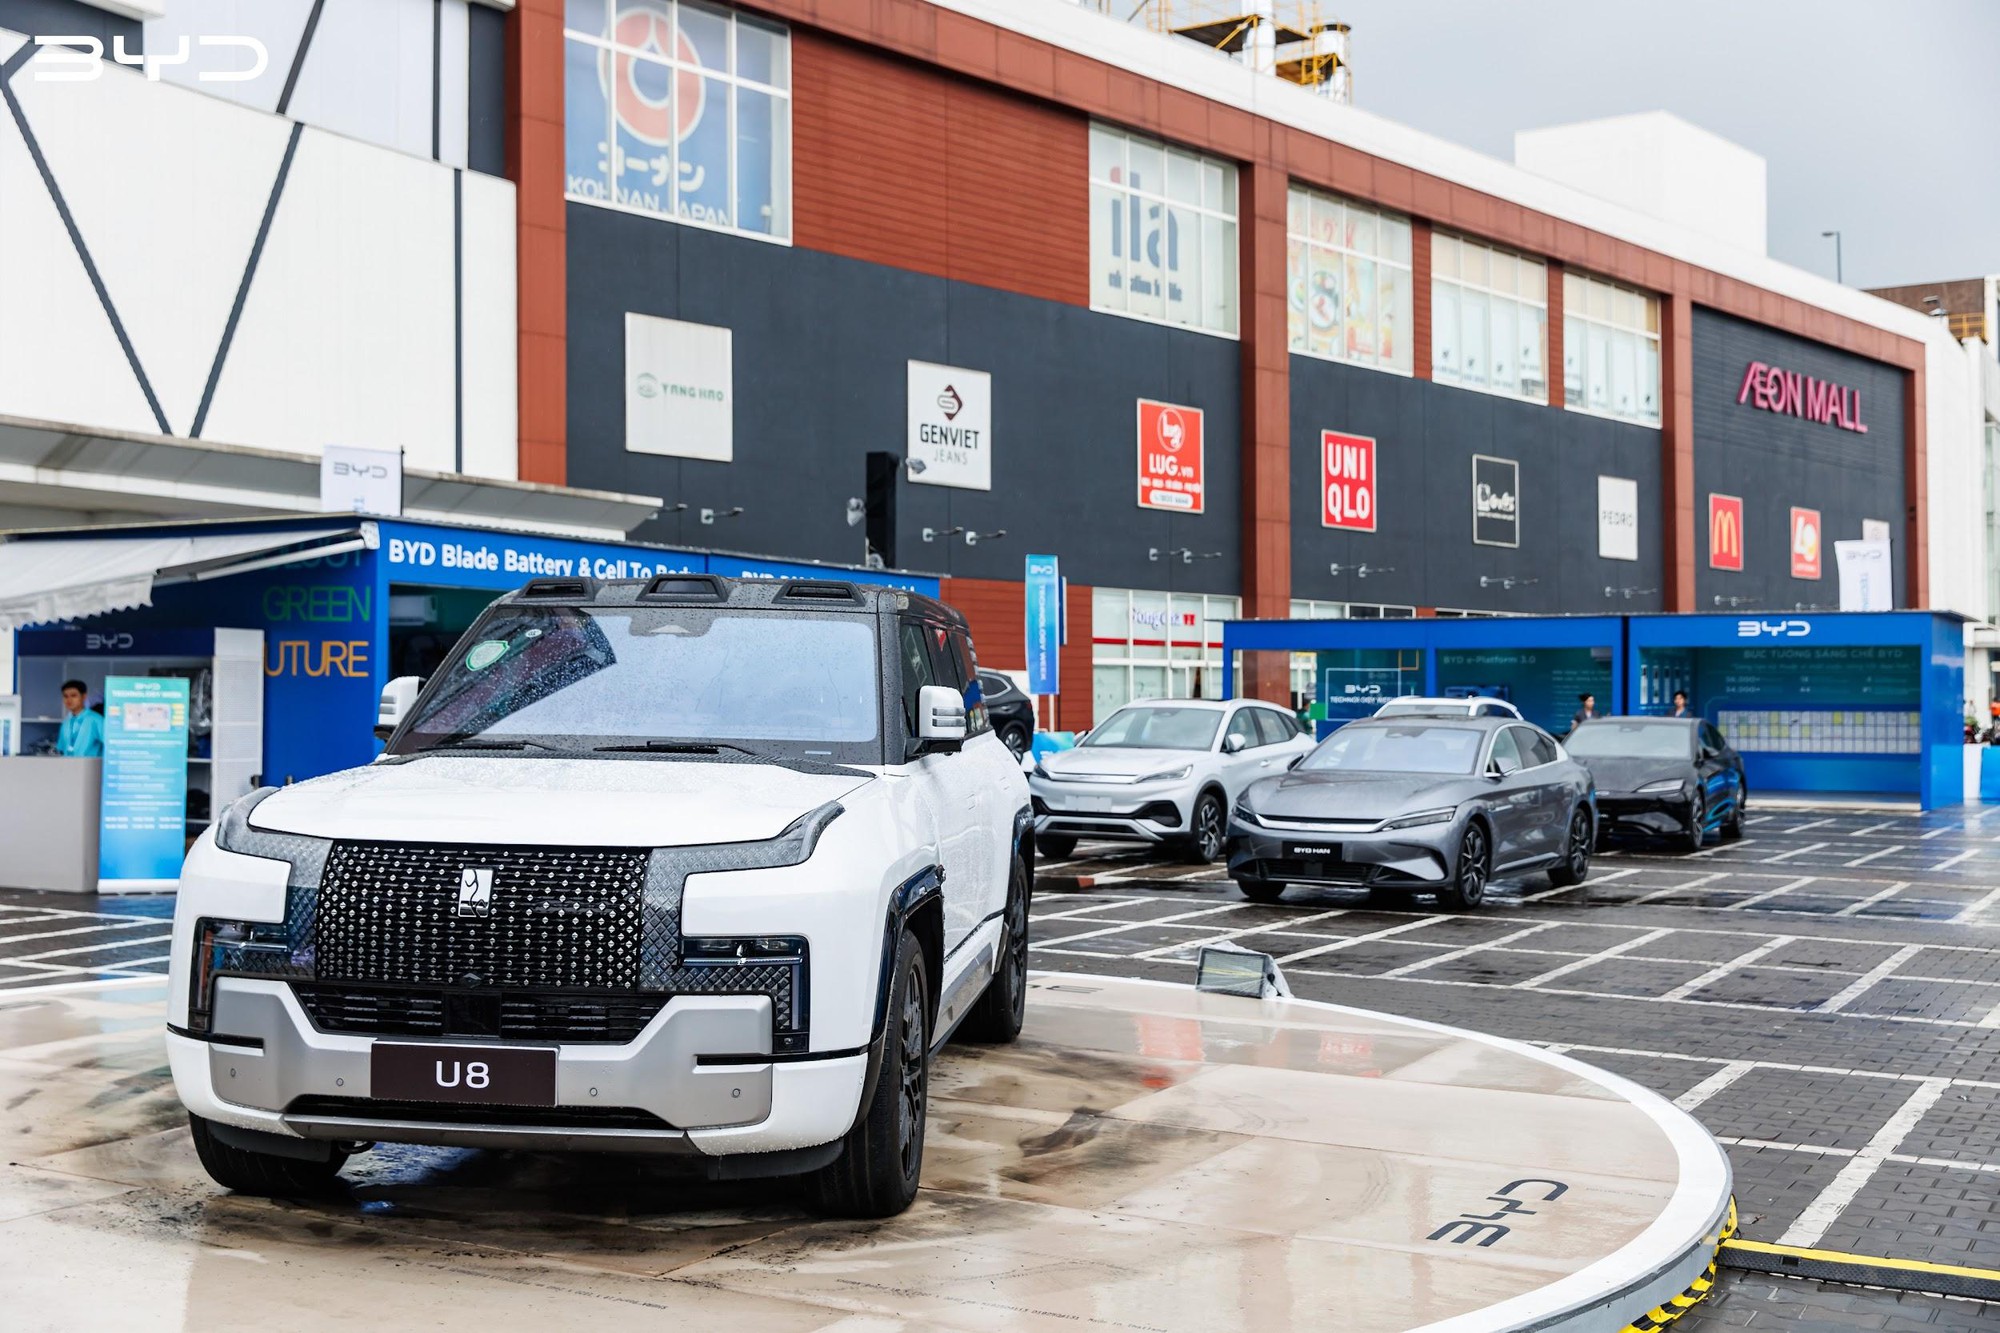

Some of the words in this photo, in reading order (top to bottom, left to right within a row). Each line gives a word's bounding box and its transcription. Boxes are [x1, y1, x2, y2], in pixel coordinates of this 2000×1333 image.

[1807, 376, 1868, 434] MALL
[920, 423, 980, 450] GENVIET
[333, 461, 388, 479] BYD
[934, 449, 968, 466] JEANS
[1149, 452, 1194, 479] LUG.vn
[1327, 442, 1367, 481] UNI
[1327, 483, 1371, 523] QLO
[1602, 510, 1633, 527] PEDRO
[389, 538, 436, 566] BYD
[441, 543, 499, 571] Blade
[504, 549, 573, 577] Battery
[578, 557, 592, 578] &
[594, 558, 627, 581] Cell
[629, 561, 653, 579] To
[262, 585, 372, 622] GREEN
[86, 633, 134, 650] BYD
[1737, 620, 1811, 637] BYD
[262, 640, 369, 677] UTURE
[1344, 684, 1381, 694] BYD
[435, 1060, 490, 1089] U8
[1425, 1178, 1569, 1248] BYD
